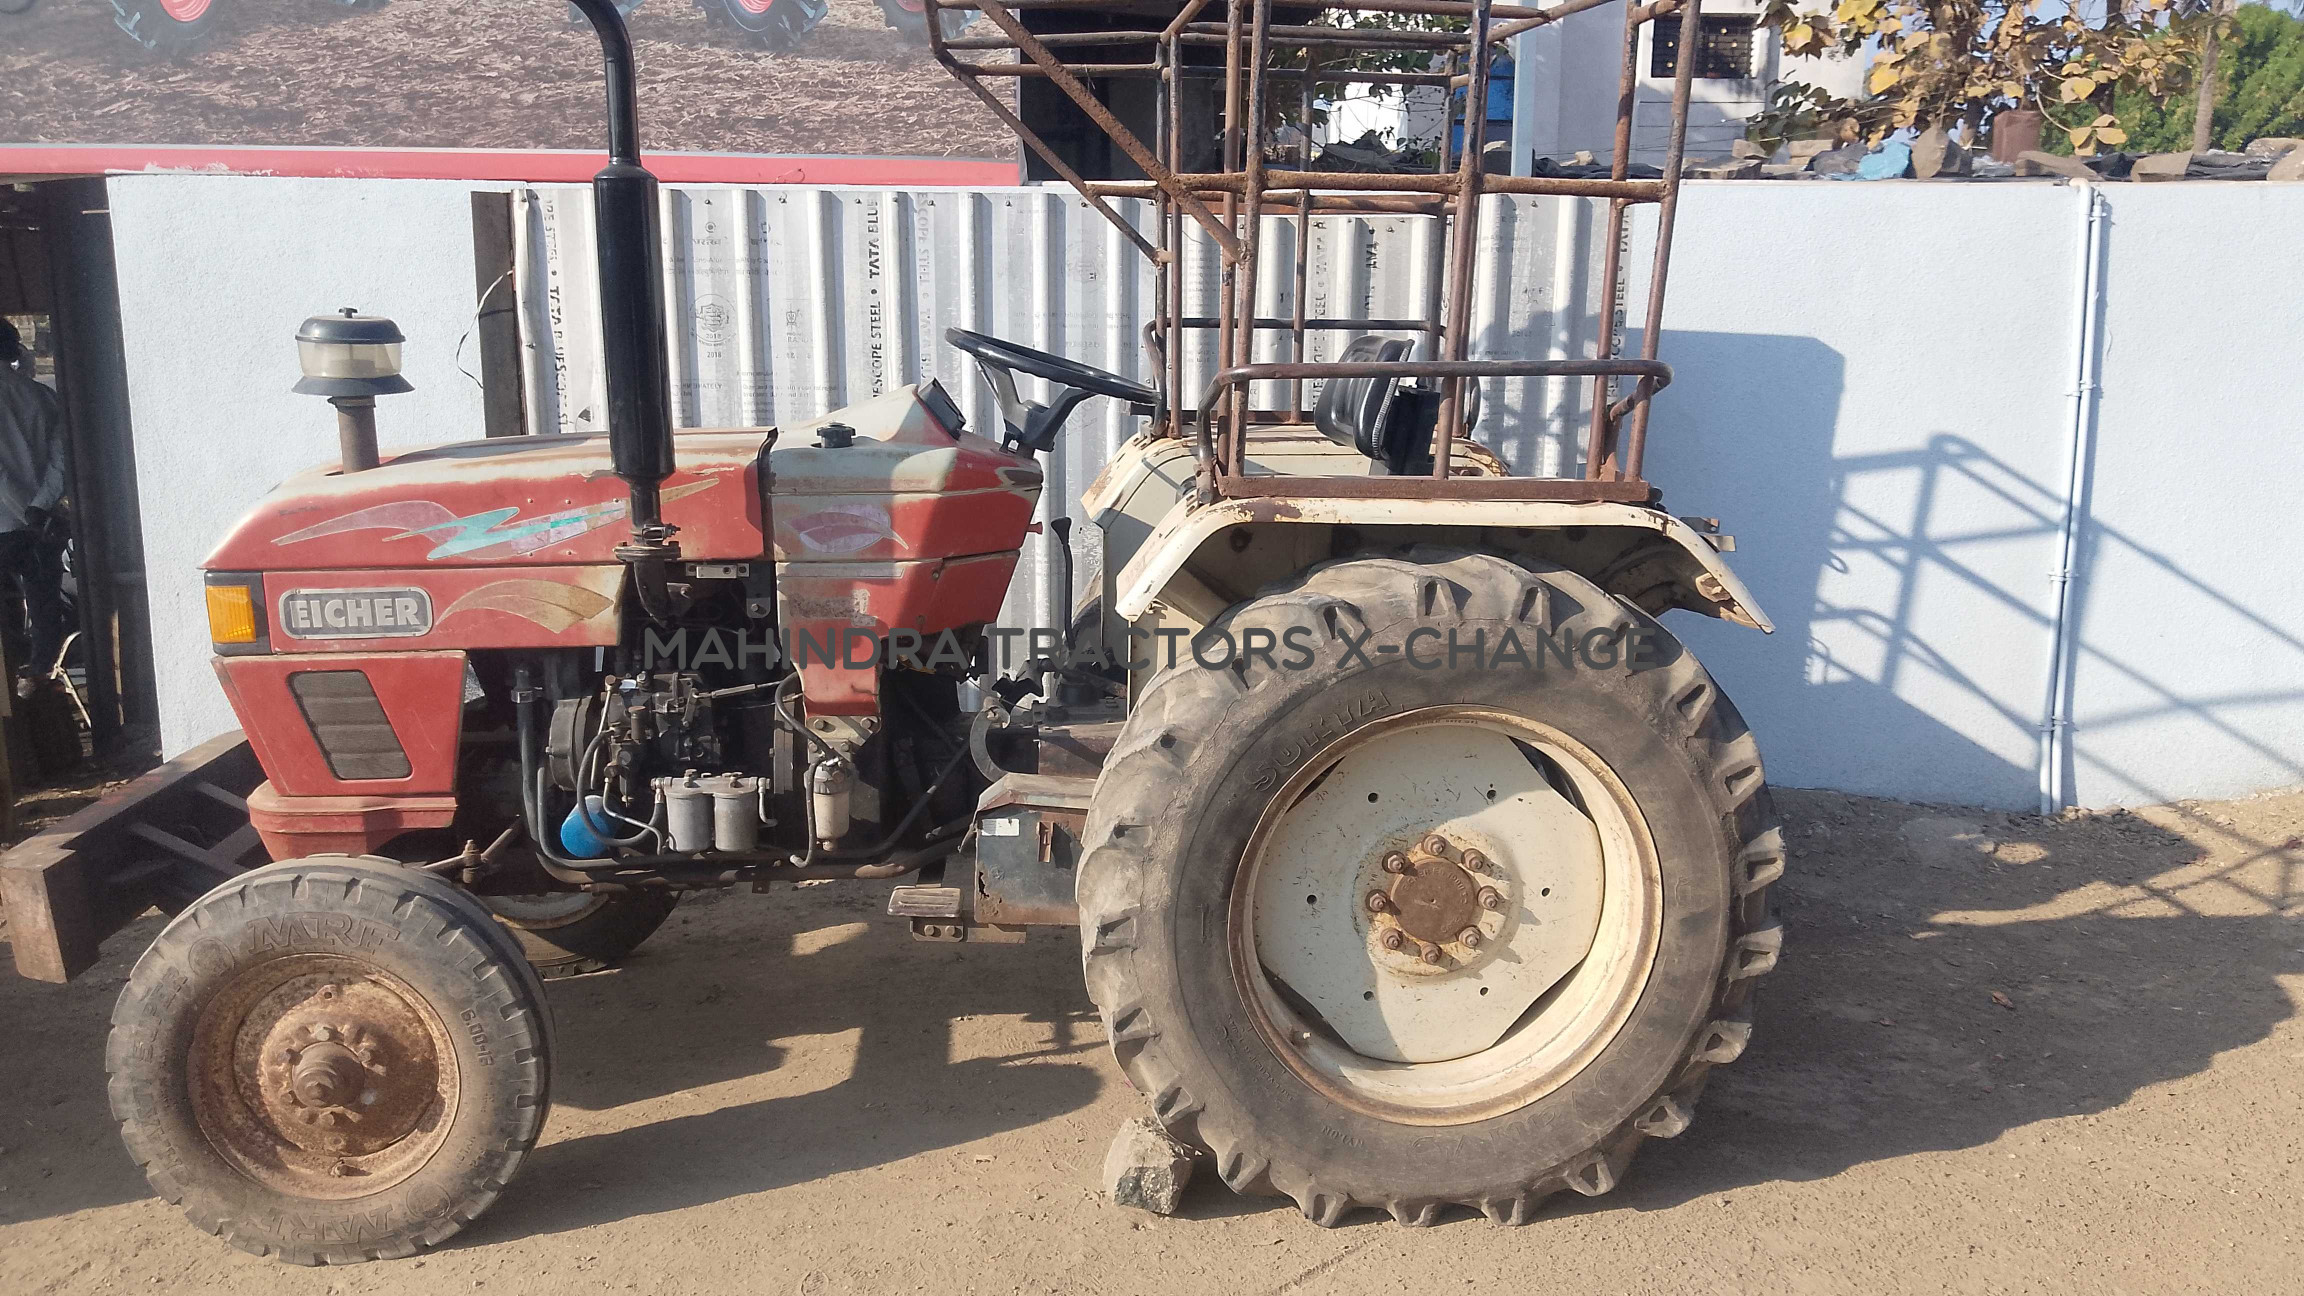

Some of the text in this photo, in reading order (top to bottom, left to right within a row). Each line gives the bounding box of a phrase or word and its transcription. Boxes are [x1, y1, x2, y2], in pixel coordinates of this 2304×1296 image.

[868, 237, 881, 280] TATA
[870, 301, 882, 340] STEEL
[706, 351, 722, 359] 2018
[289, 596, 420, 628] EICHER
[246, 911, 401, 954] MRF
